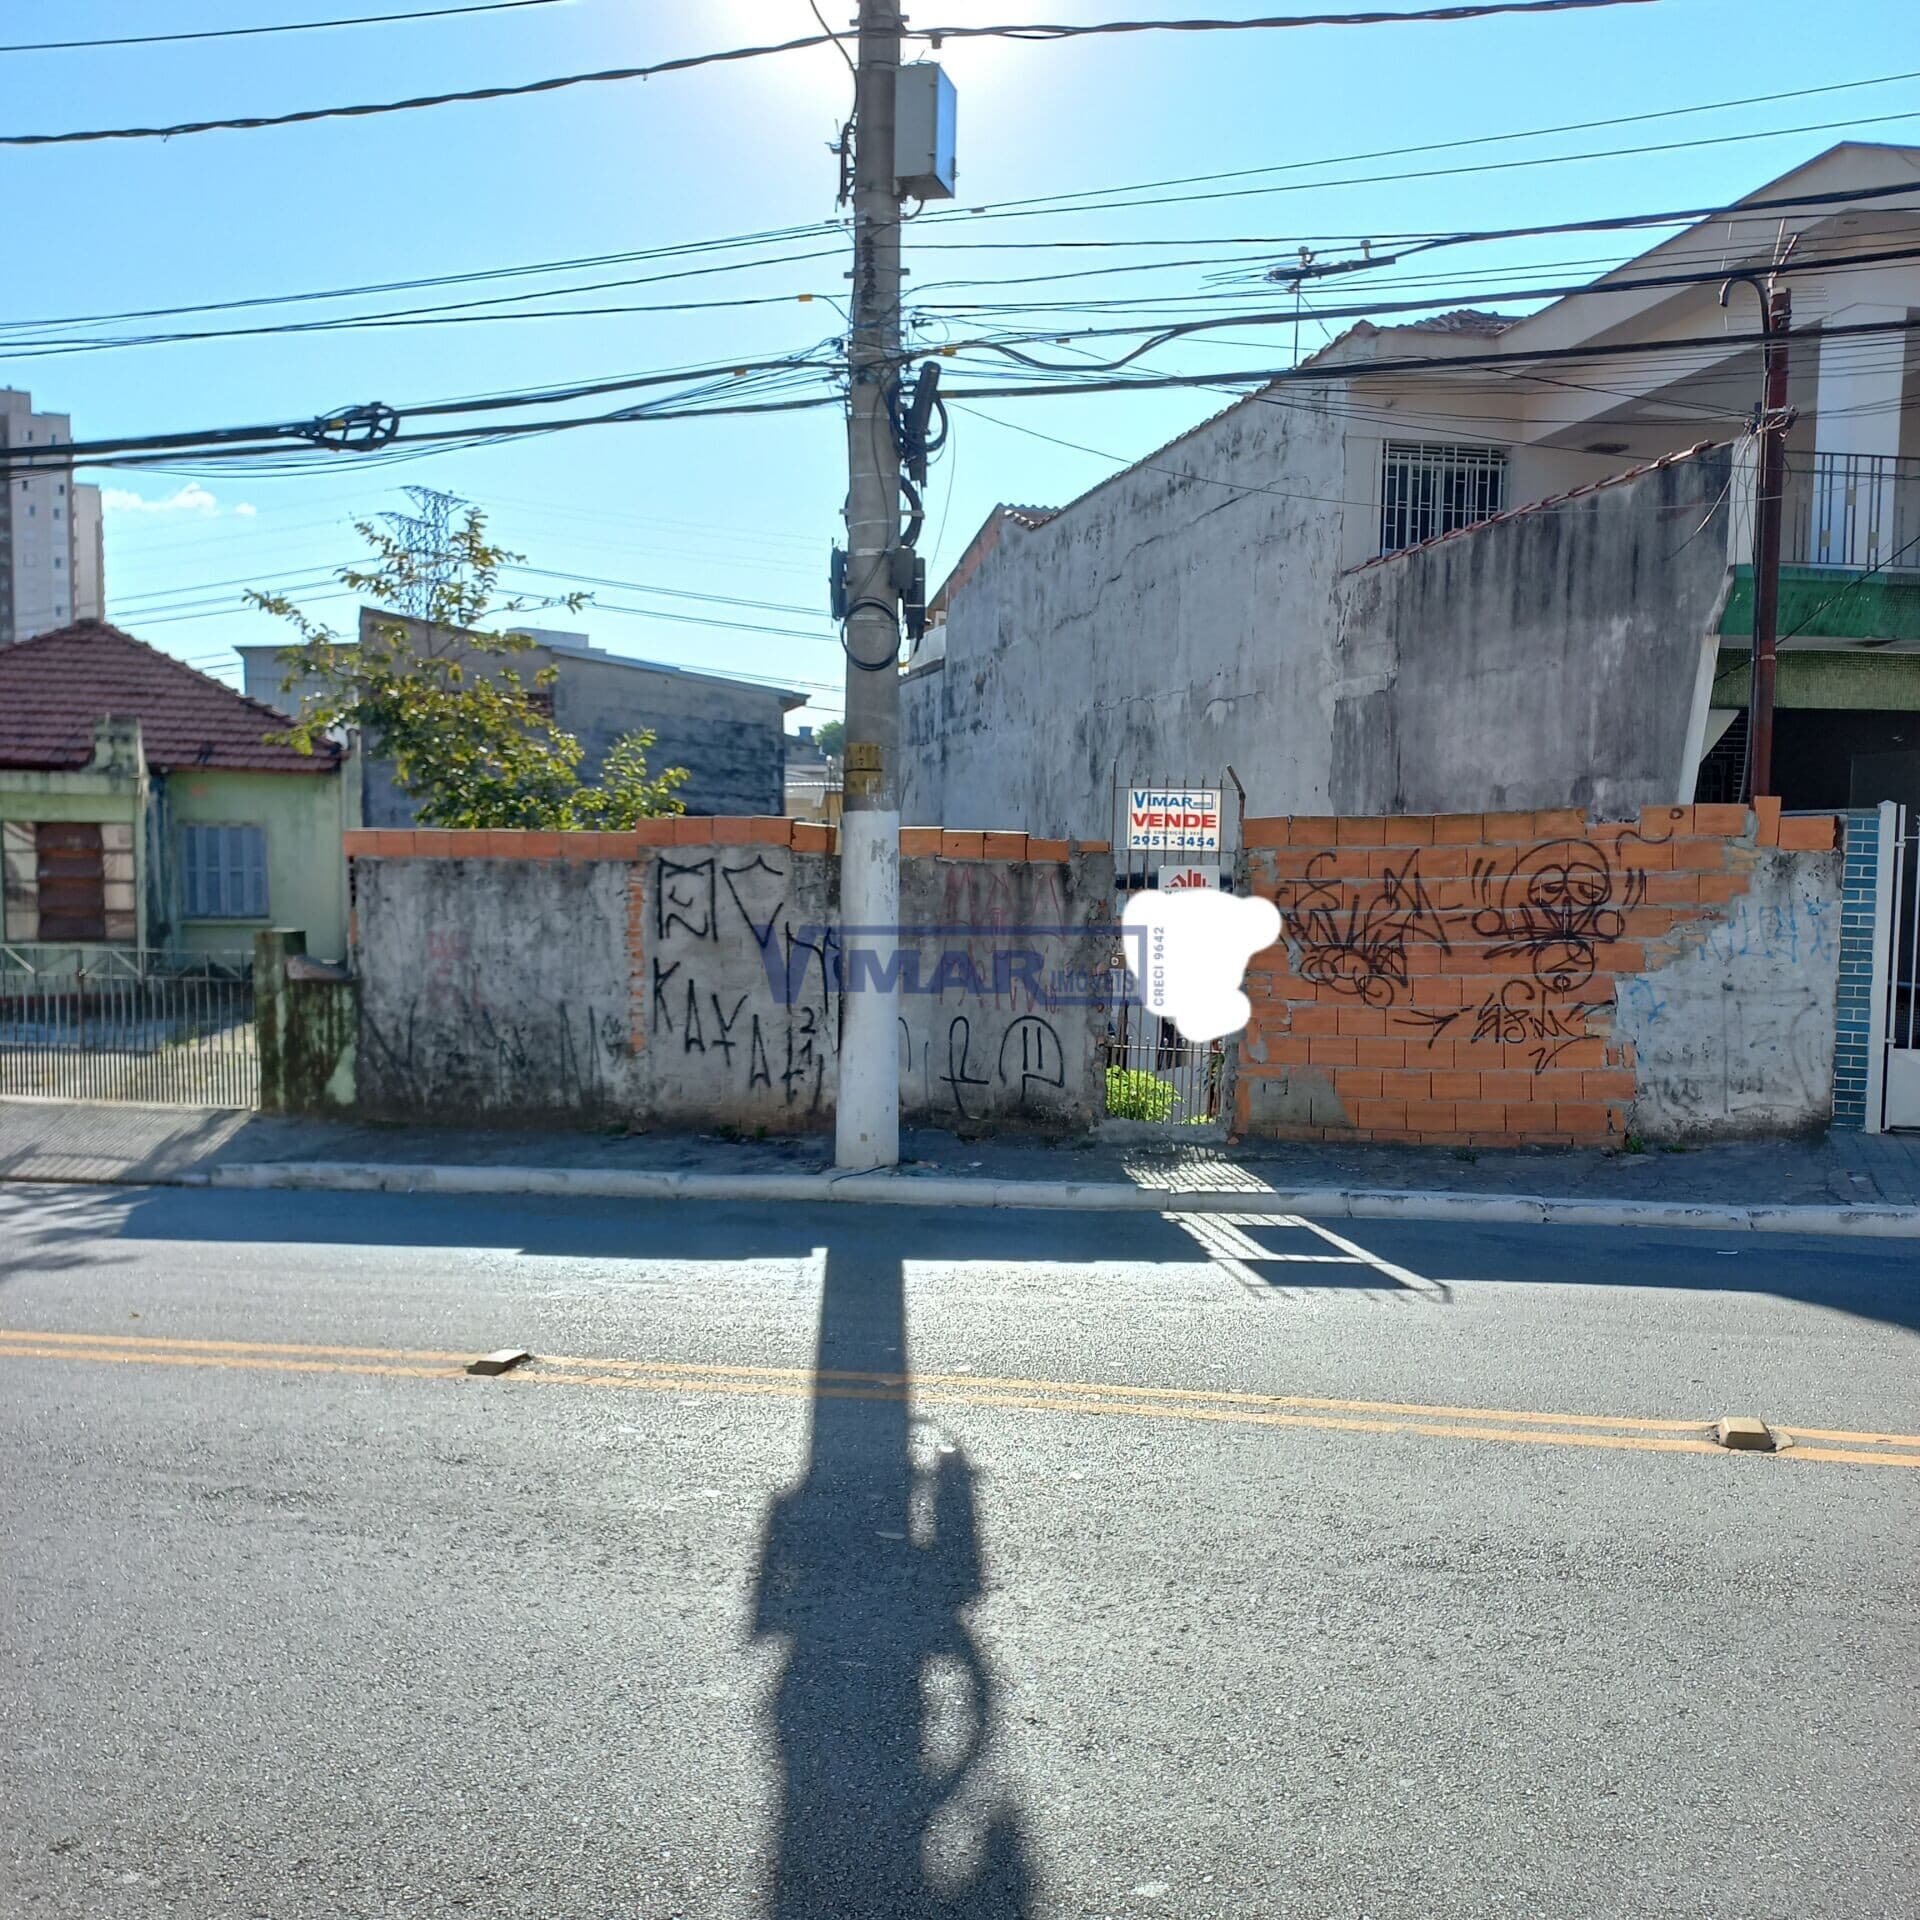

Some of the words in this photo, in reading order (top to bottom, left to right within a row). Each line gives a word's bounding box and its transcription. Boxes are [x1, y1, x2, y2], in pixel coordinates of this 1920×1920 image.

[1134, 791, 1193, 809] VIMAR
[1132, 812, 1217, 828] VENDE
[1132, 835, 1215, 847] 2951-3454
